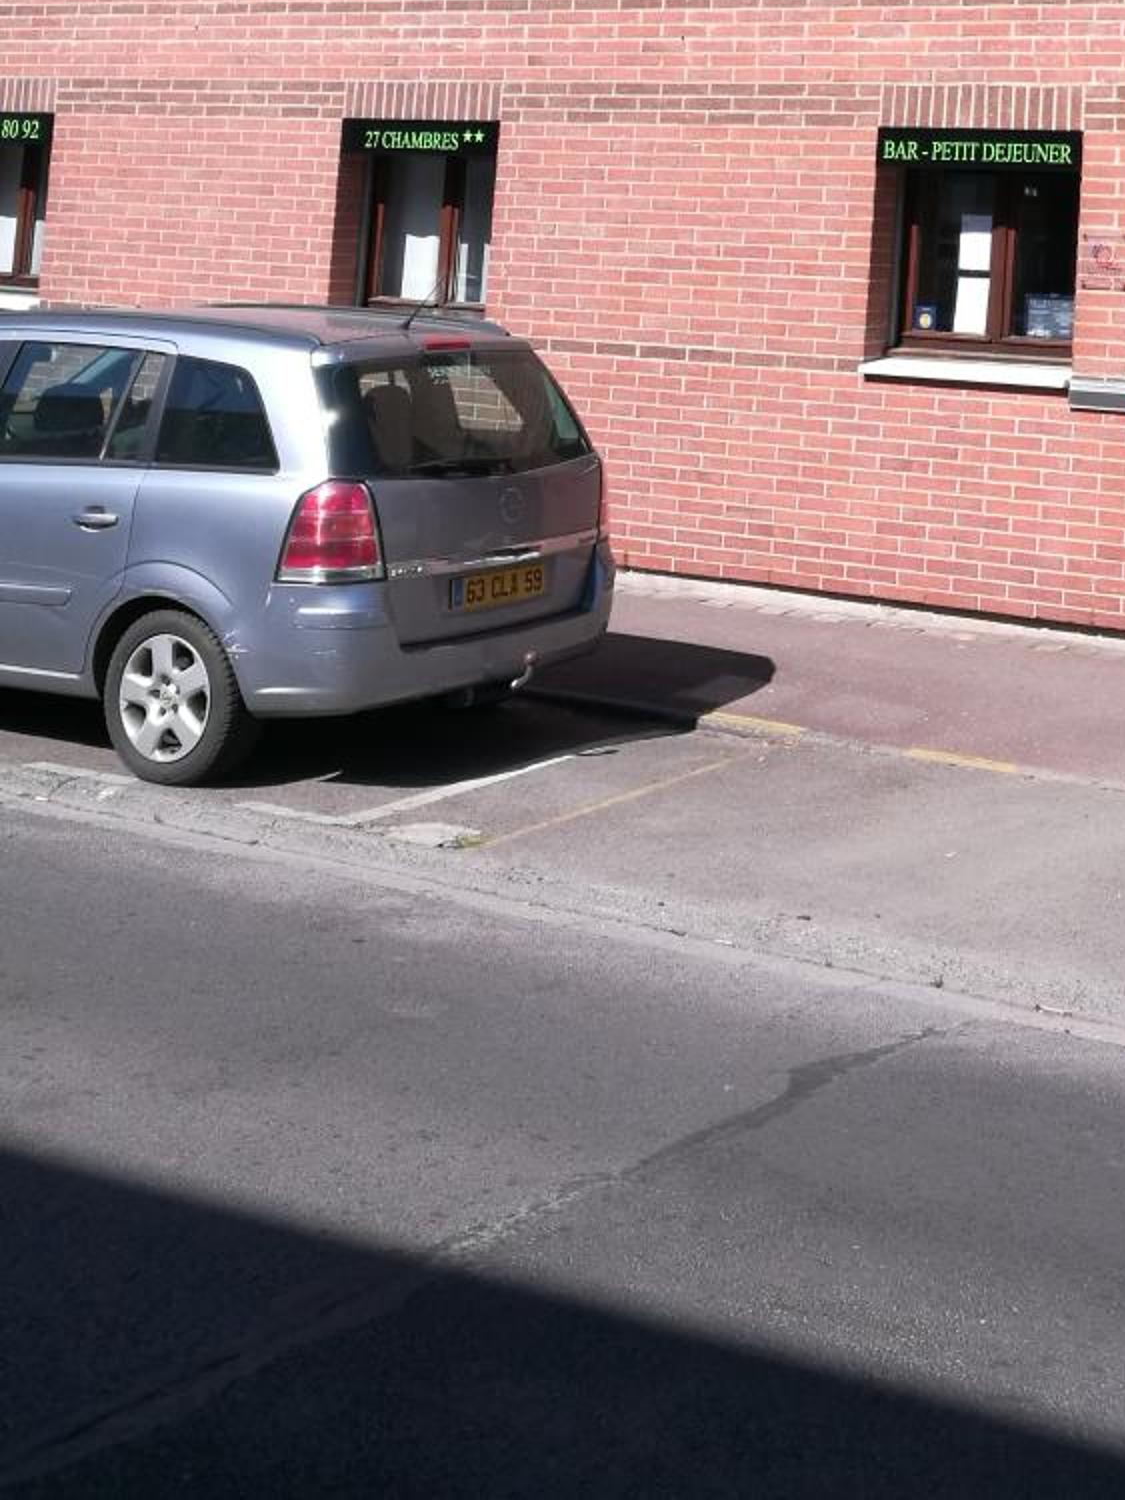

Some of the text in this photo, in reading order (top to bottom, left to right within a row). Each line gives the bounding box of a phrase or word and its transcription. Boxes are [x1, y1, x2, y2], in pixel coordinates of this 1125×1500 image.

[21, 119, 39, 139] 92
[364, 131, 459, 150] 27 CHAMBRES
[882, 140, 919, 160] BAR
[931, 141, 980, 161] PETIT
[981, 143, 1073, 165] DEJEUNER
